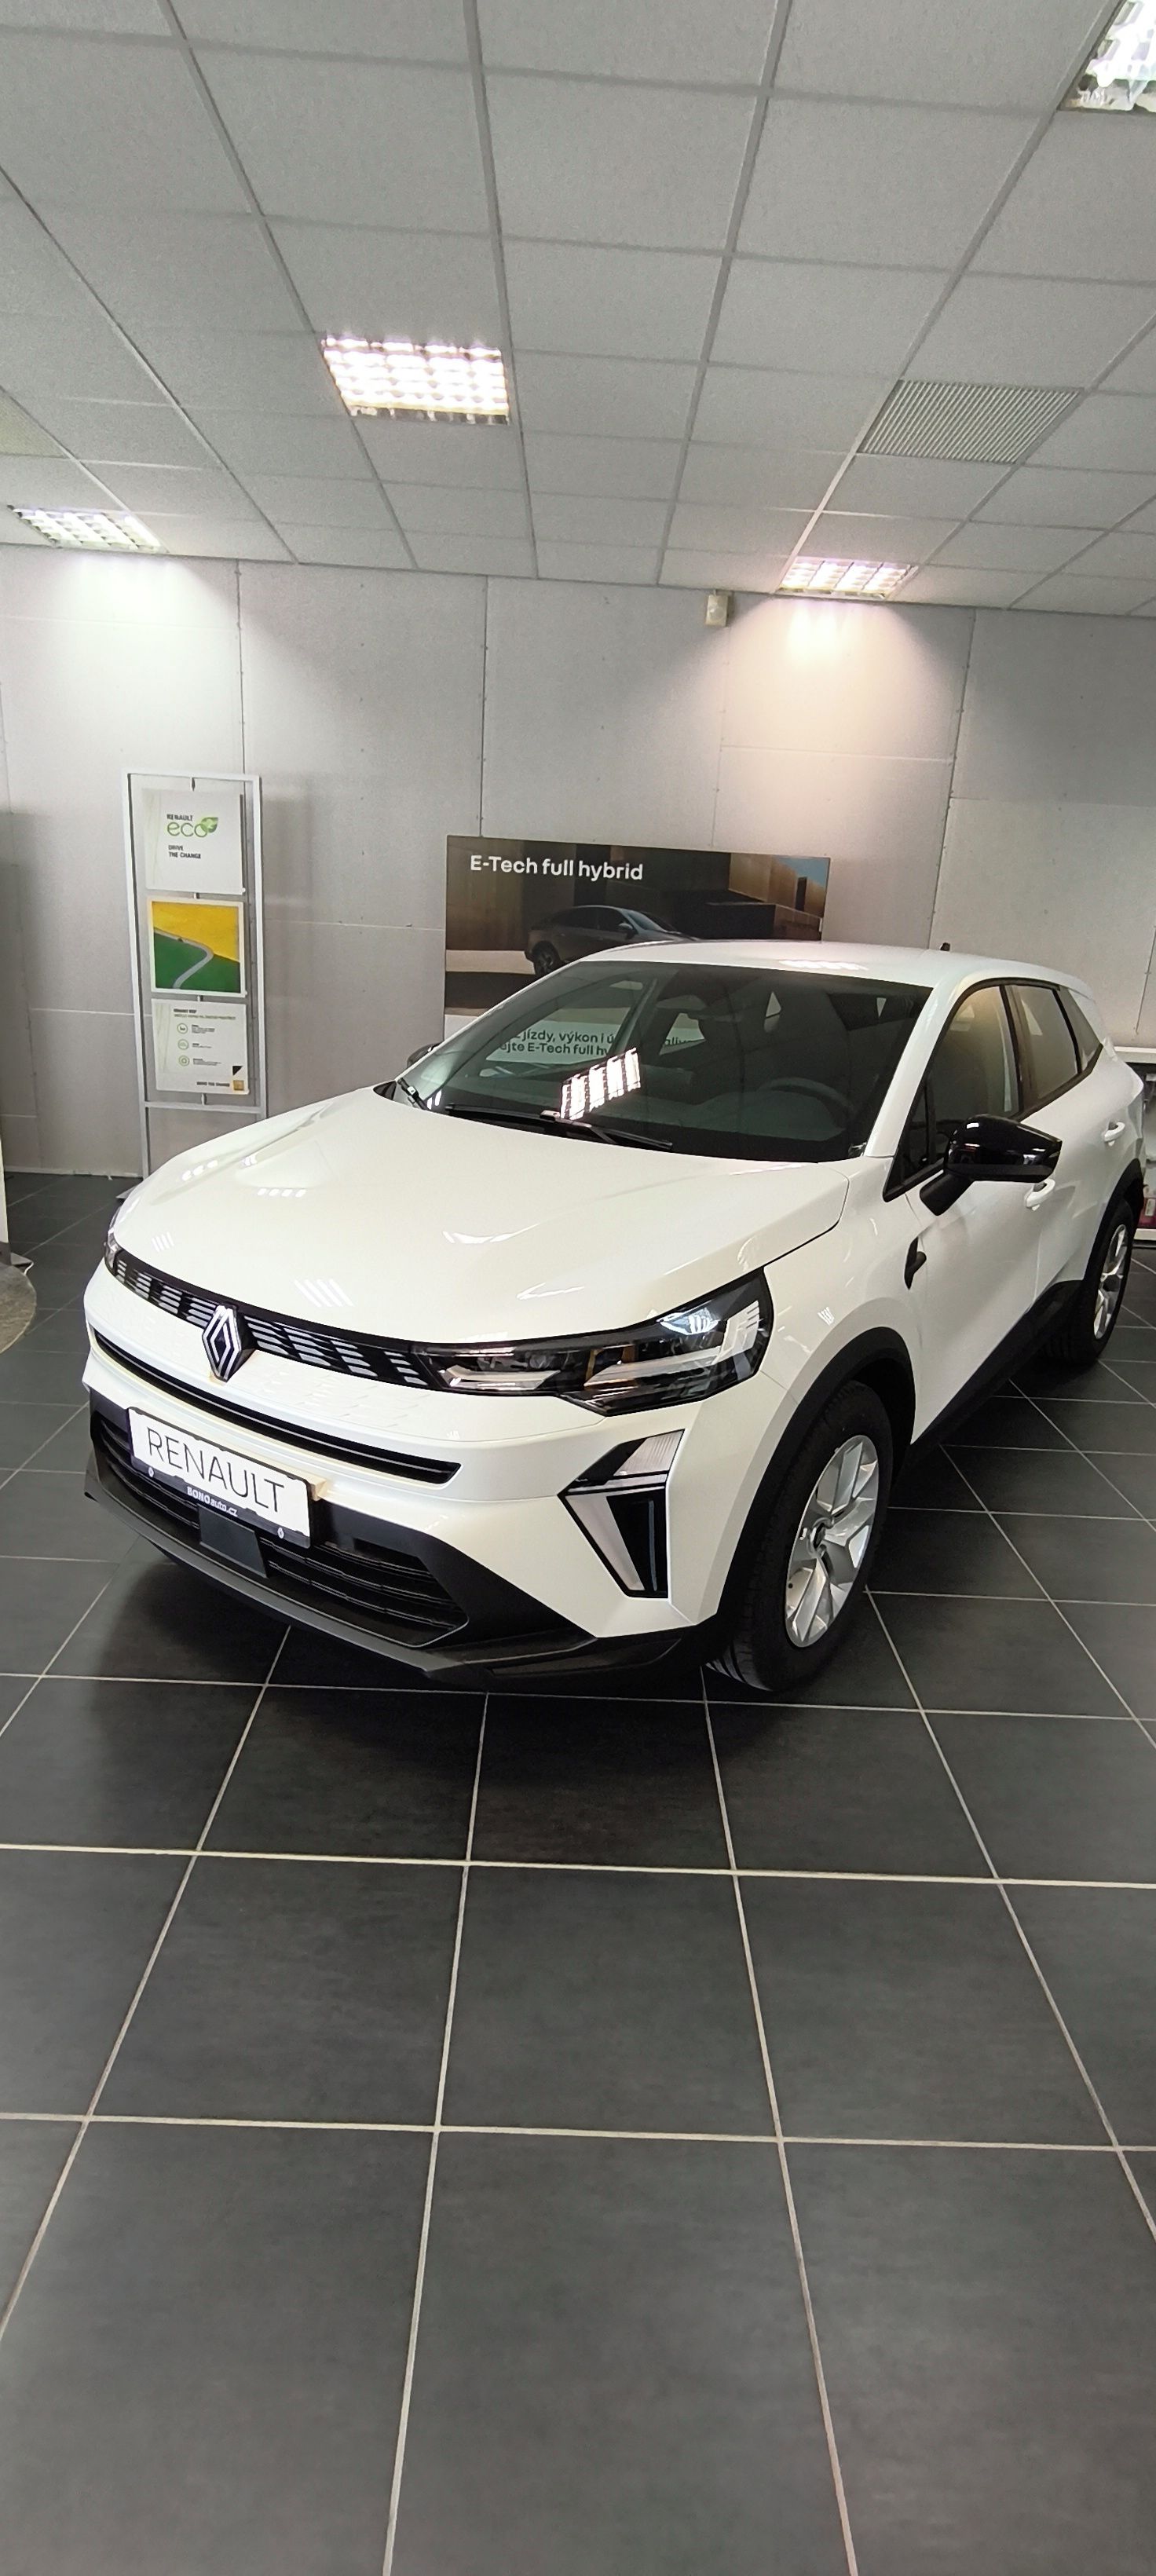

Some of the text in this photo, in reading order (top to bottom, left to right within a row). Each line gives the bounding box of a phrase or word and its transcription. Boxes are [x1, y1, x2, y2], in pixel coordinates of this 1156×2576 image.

[167, 821, 208, 838] eco
[470, 854, 643, 881] E-Tech full hybrid
[521, 1028, 555, 1044] jízdy,
[559, 1030, 598, 1045] výkon
[527, 1042, 571, 1053] E-Tech
[573, 1044, 594, 1056] full
[147, 1426, 285, 1513] RENAULT
